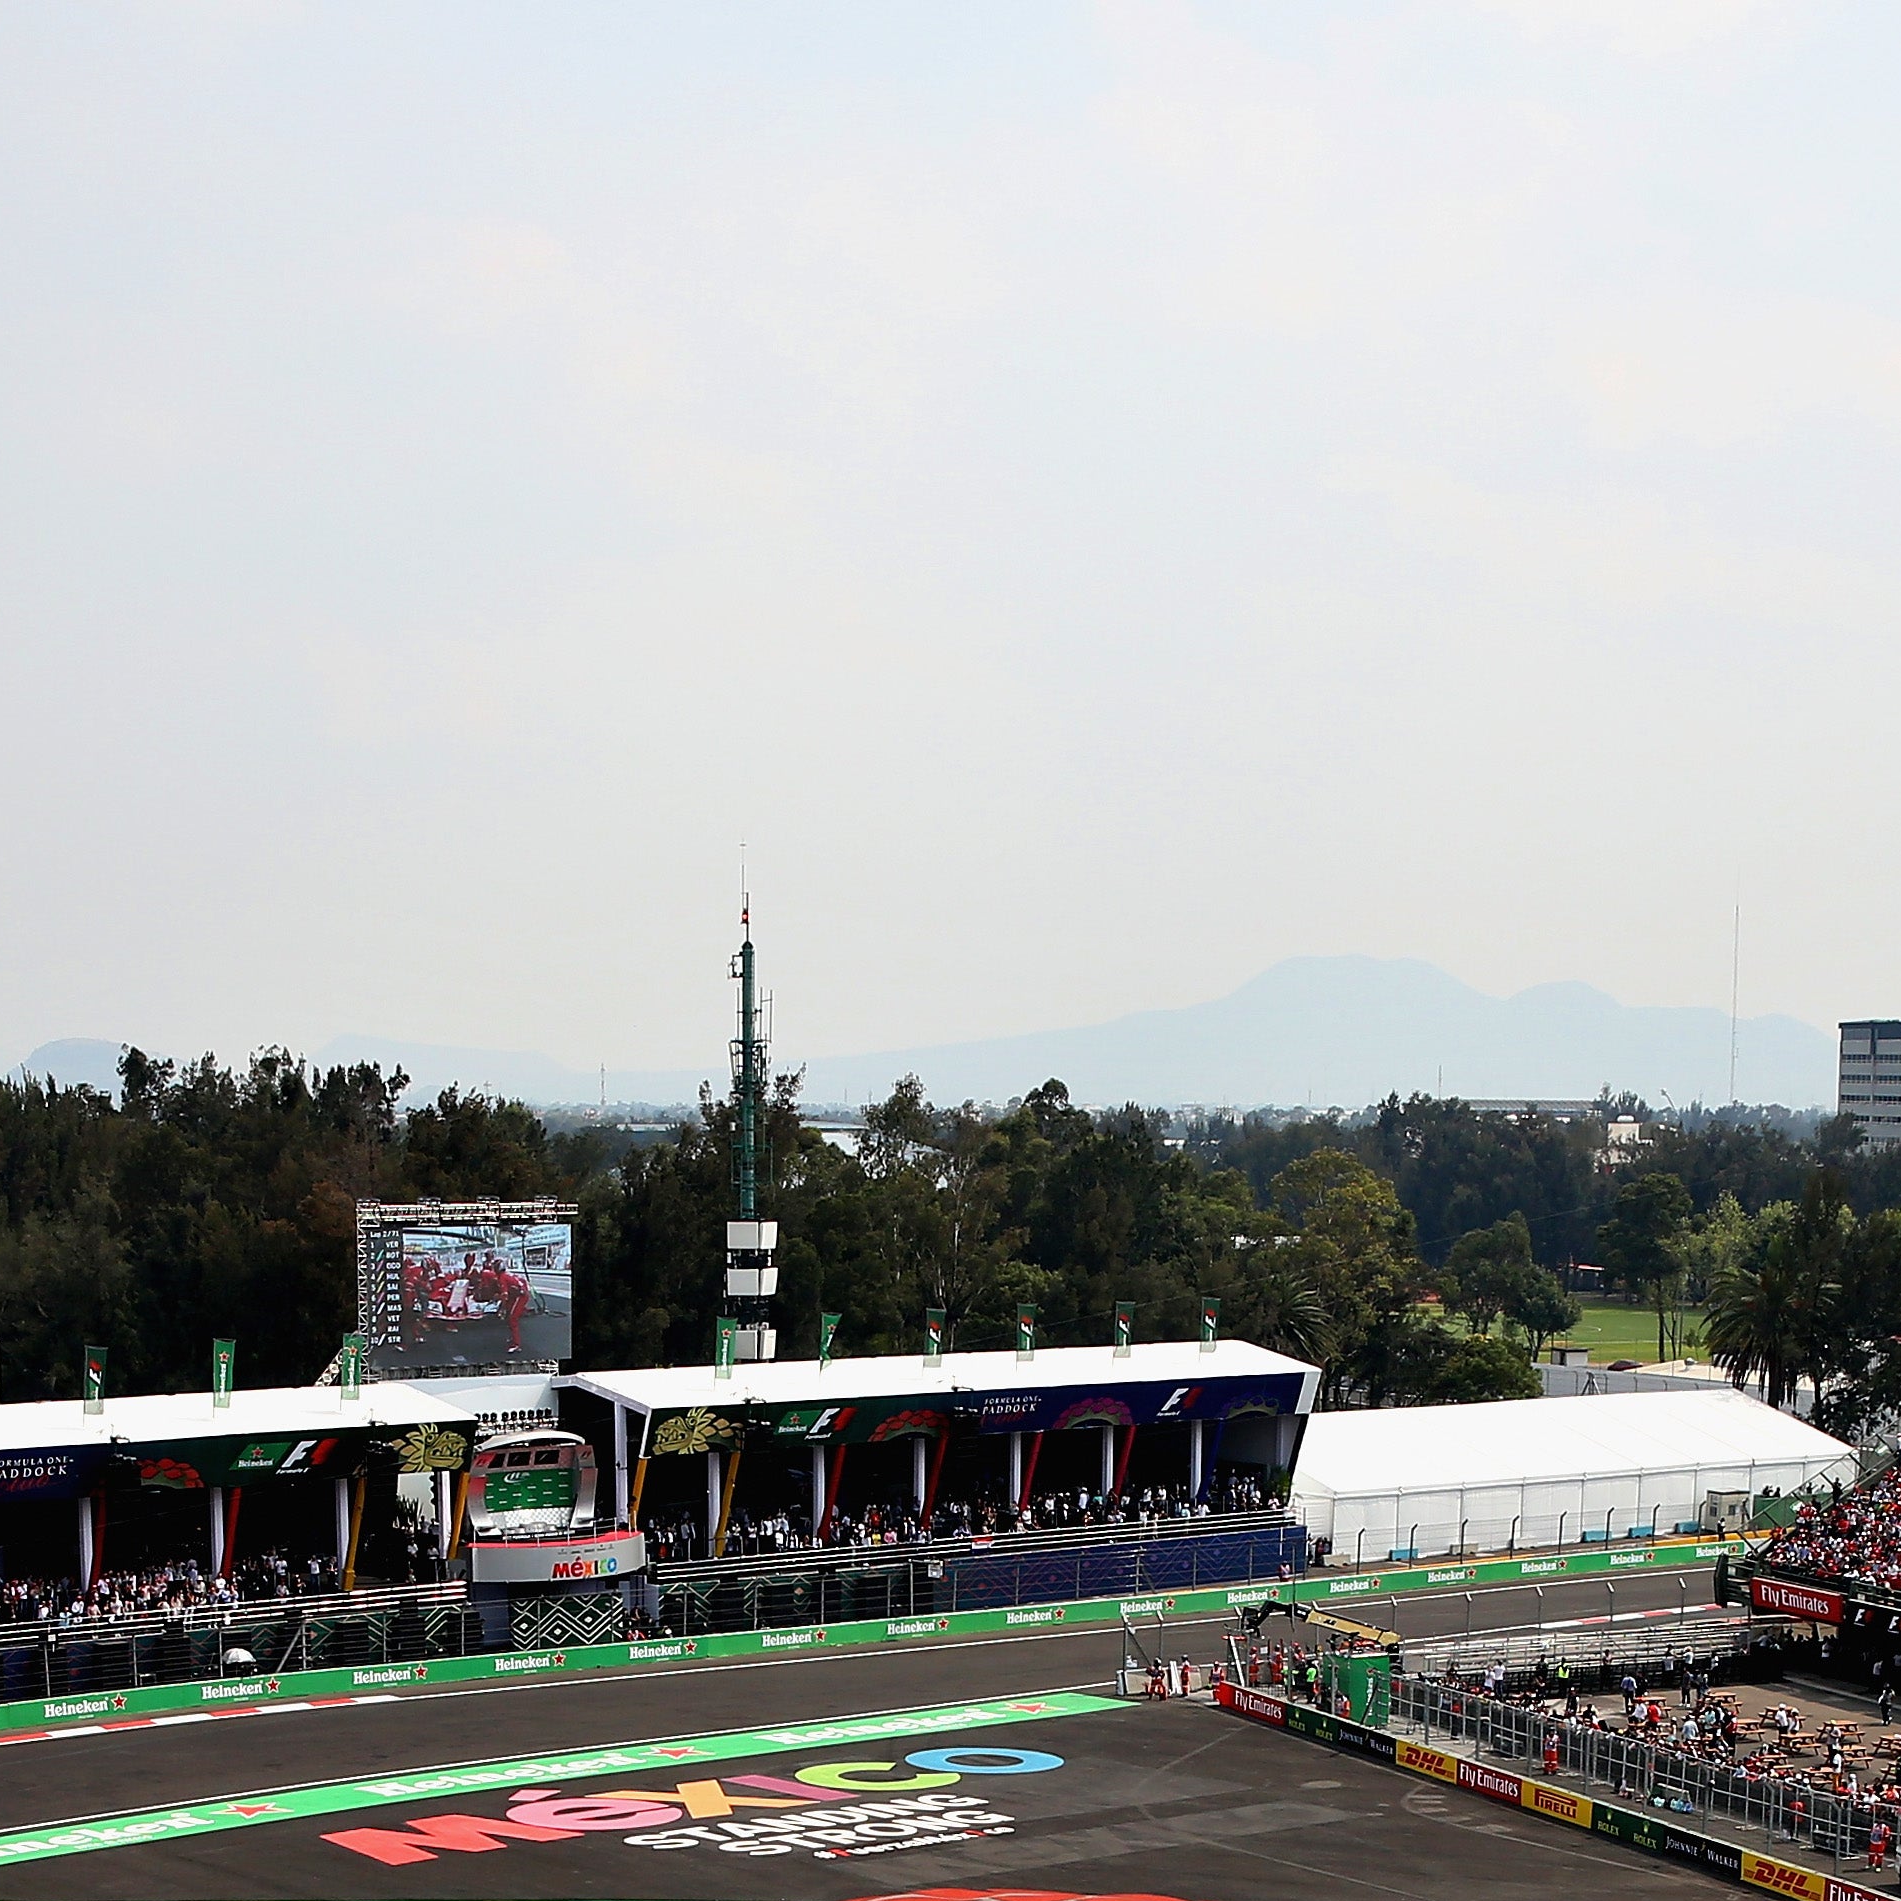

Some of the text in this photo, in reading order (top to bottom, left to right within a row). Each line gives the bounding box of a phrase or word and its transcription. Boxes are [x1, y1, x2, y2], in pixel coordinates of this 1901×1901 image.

[982, 1403, 1037, 1415] PADDOCK
[1610, 1551, 1647, 1566] Heineken
[1696, 1544, 1732, 1558] Heineken
[1428, 1567, 1466, 1583] Heineken
[1521, 1559, 1558, 1575] Heineken
[1330, 1578, 1370, 1593] Heineken
[1227, 1588, 1269, 1605] Heineken
[1760, 1584, 1829, 1615] Fly Emirates
[1120, 1600, 1165, 1615] Heineken
[1006, 1609, 1054, 1624] Heineken
[887, 1620, 937, 1634] Heineken
[762, 1631, 813, 1646] Heineken
[629, 1642, 683, 1659] Heineken
[494, 1654, 552, 1672] Heineken
[352, 1667, 413, 1685] Heineken
[201, 1681, 264, 1699] Heineken
[44, 1699, 110, 1718] Heineken
[1235, 1690, 1282, 1720] Fly Emirates
[1405, 1746, 1446, 1775] DHL
[355, 1751, 648, 1799] Heineken
[1460, 1764, 1518, 1798] Fly Emirates
[1534, 1788, 1578, 1818] PIRELLI
[623, 1793, 990, 1850] STANDING
[1597, 1820, 1619, 1836] ROLEX
[718, 1810, 1016, 1857] STRONG
[1633, 1832, 1657, 1849] ROLEX
[1665, 1836, 1739, 1869] JOHNNIE WALKER
[1754, 1860, 1813, 1898] DHL
